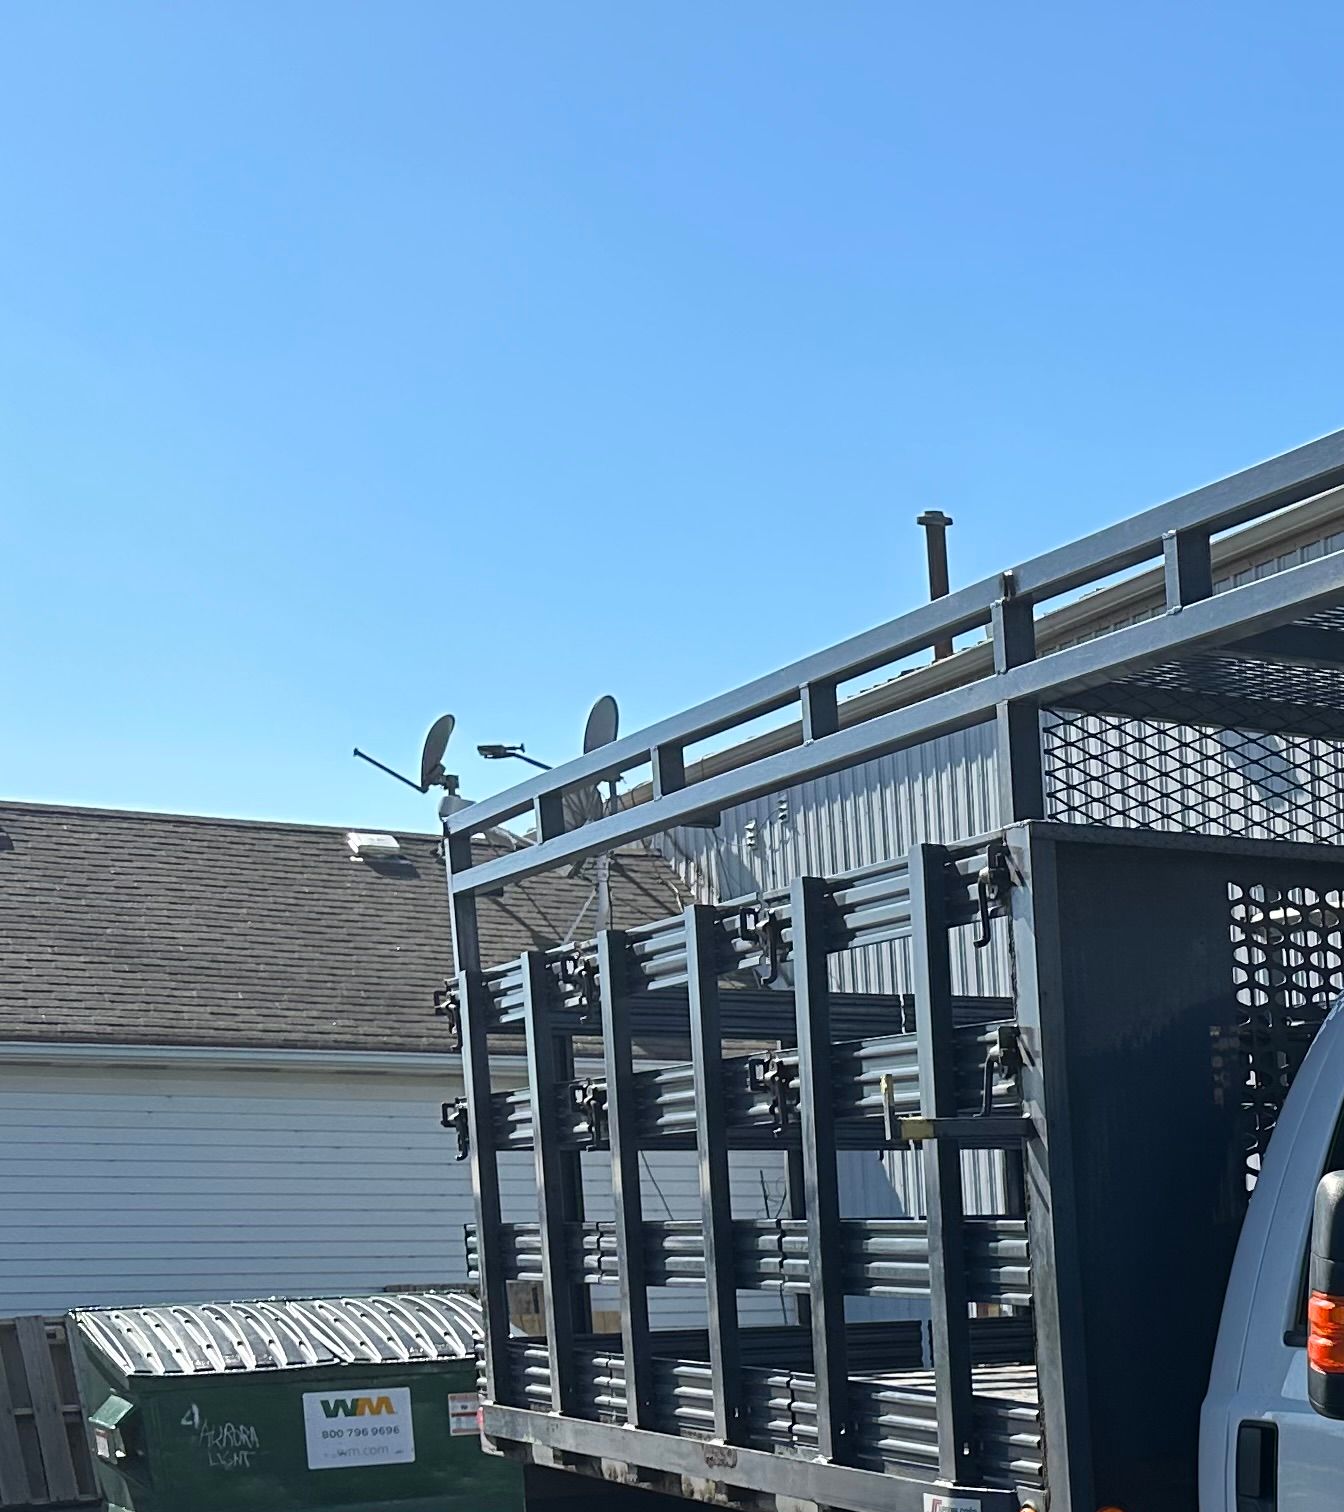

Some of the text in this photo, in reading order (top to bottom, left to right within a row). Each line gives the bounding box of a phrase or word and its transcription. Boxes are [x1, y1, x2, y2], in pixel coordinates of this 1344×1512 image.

[320, 1396, 395, 1418] WM
[321, 1430, 343, 1440] 800
[347, 1428, 368, 1438] 796
